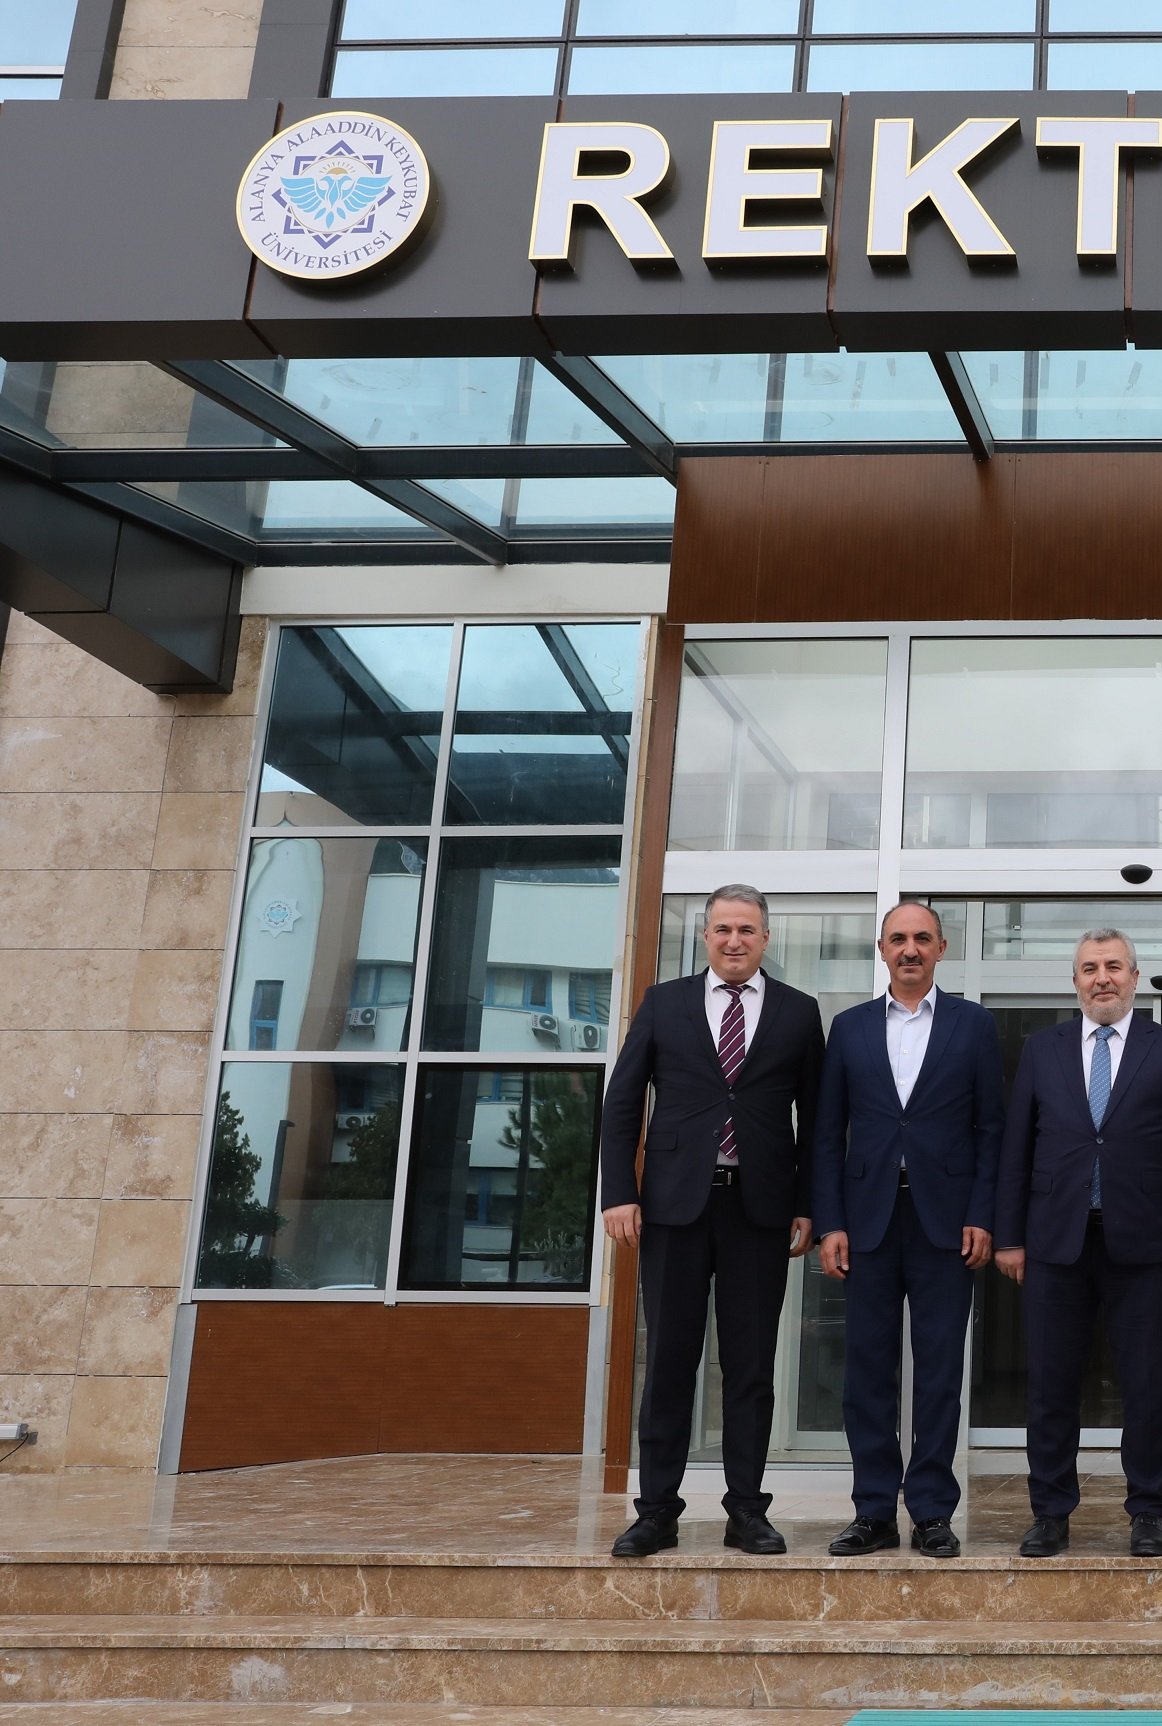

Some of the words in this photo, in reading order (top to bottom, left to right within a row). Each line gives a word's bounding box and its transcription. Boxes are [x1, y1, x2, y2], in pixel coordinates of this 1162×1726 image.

[250, 153, 285, 222] ALANYA
[287, 121, 387, 152] ALAADDİN
[384, 136, 418, 222] KEYKUBAT
[261, 230, 393, 268] ÜNİVERSİTESİ
